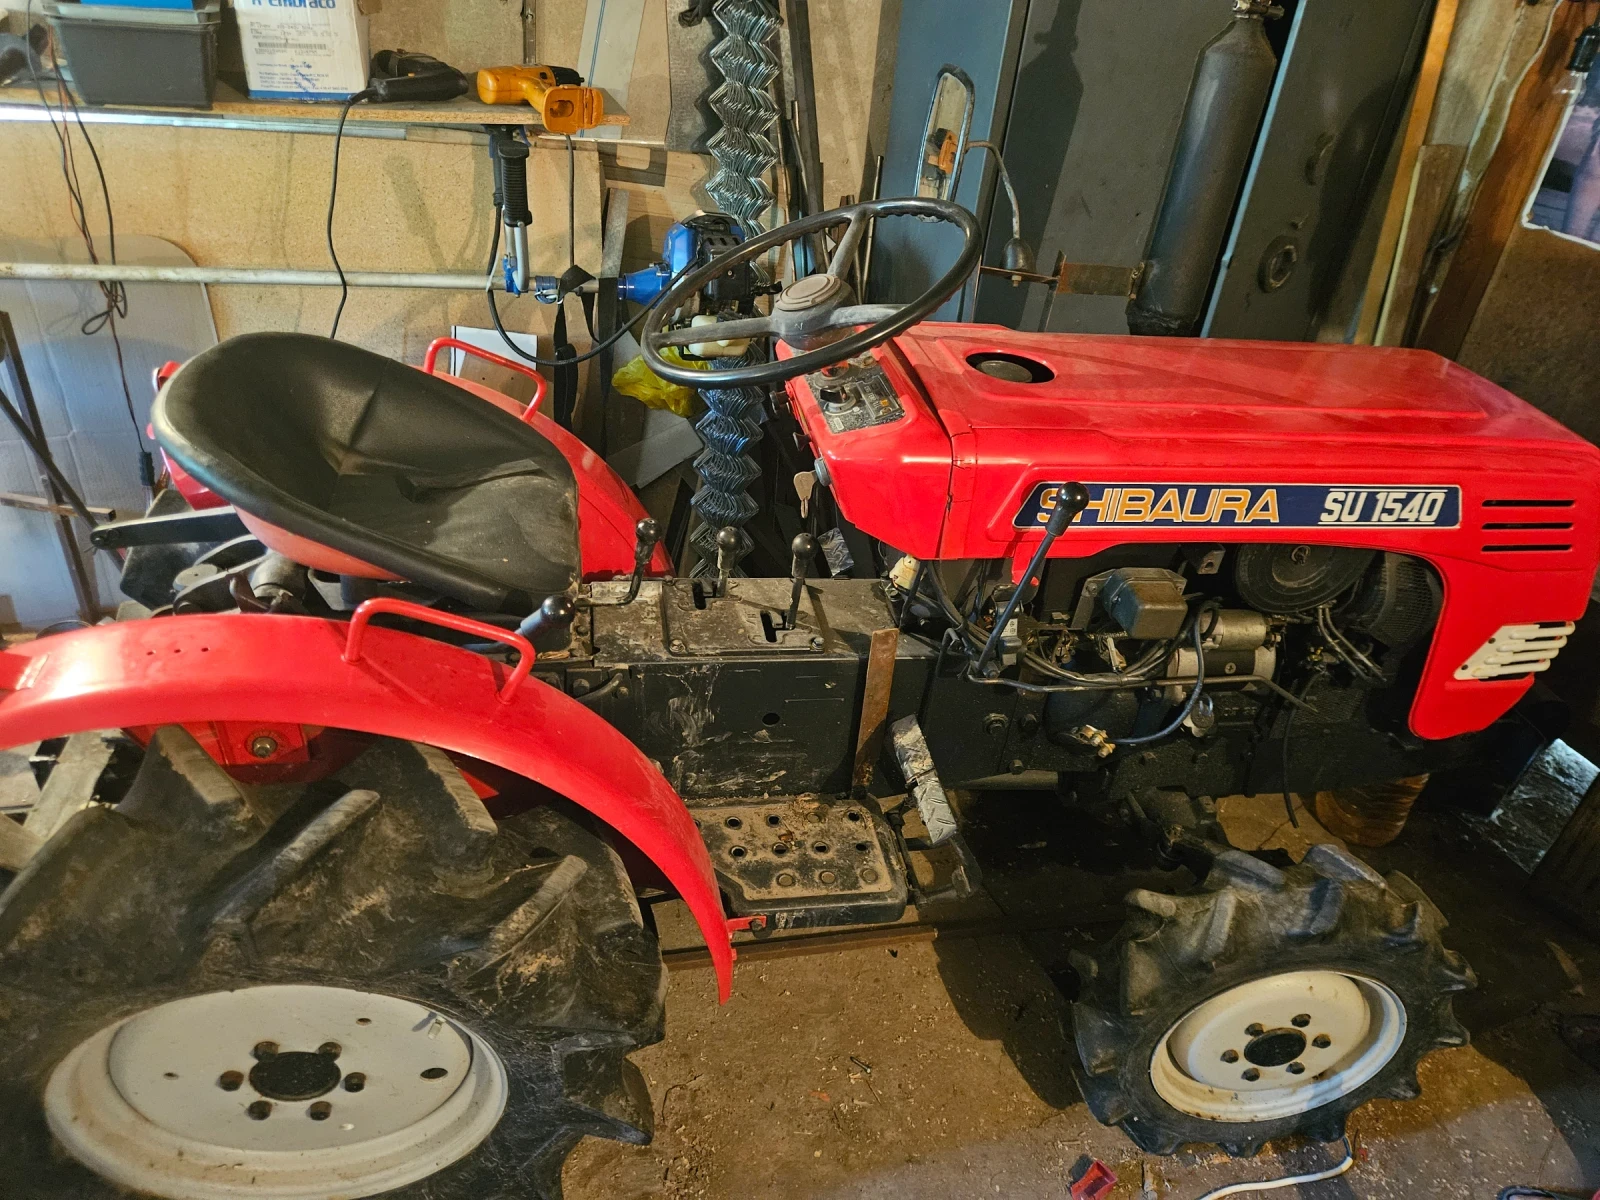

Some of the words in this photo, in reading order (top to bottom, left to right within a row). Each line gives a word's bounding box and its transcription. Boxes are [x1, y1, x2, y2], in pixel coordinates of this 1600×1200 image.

[1036, 488, 1280, 523] SHIBAURA
[1320, 491, 1368, 522] SU
[1371, 491, 1446, 522] 1540
